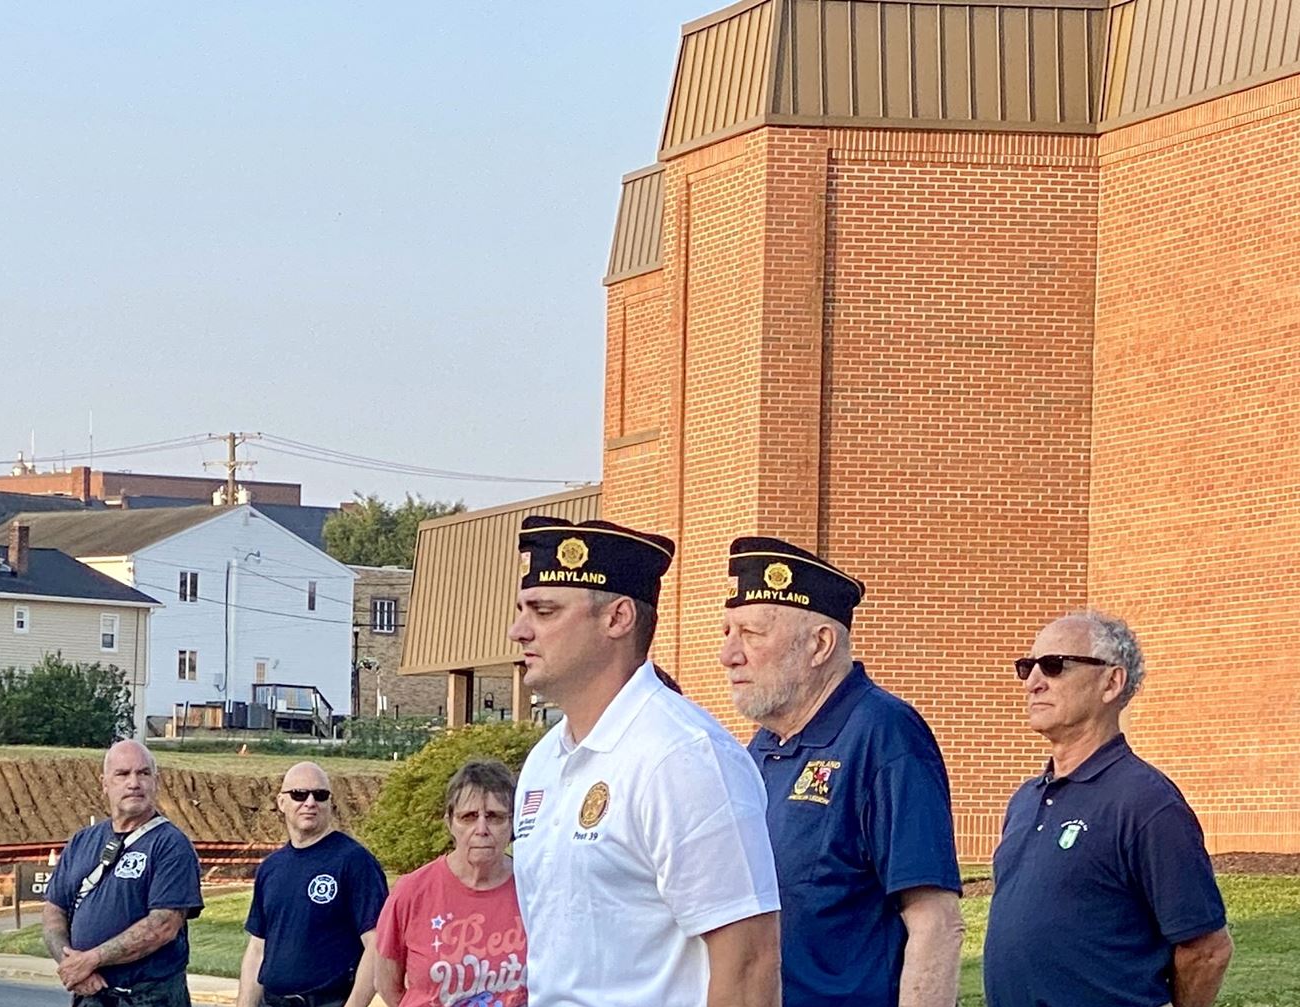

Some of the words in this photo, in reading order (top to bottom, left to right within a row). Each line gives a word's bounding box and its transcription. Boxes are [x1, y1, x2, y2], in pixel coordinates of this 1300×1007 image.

[538, 570, 607, 586] MARYLAND
[745, 589, 810, 607] MARYLAND
[441, 912, 527, 962] Red
